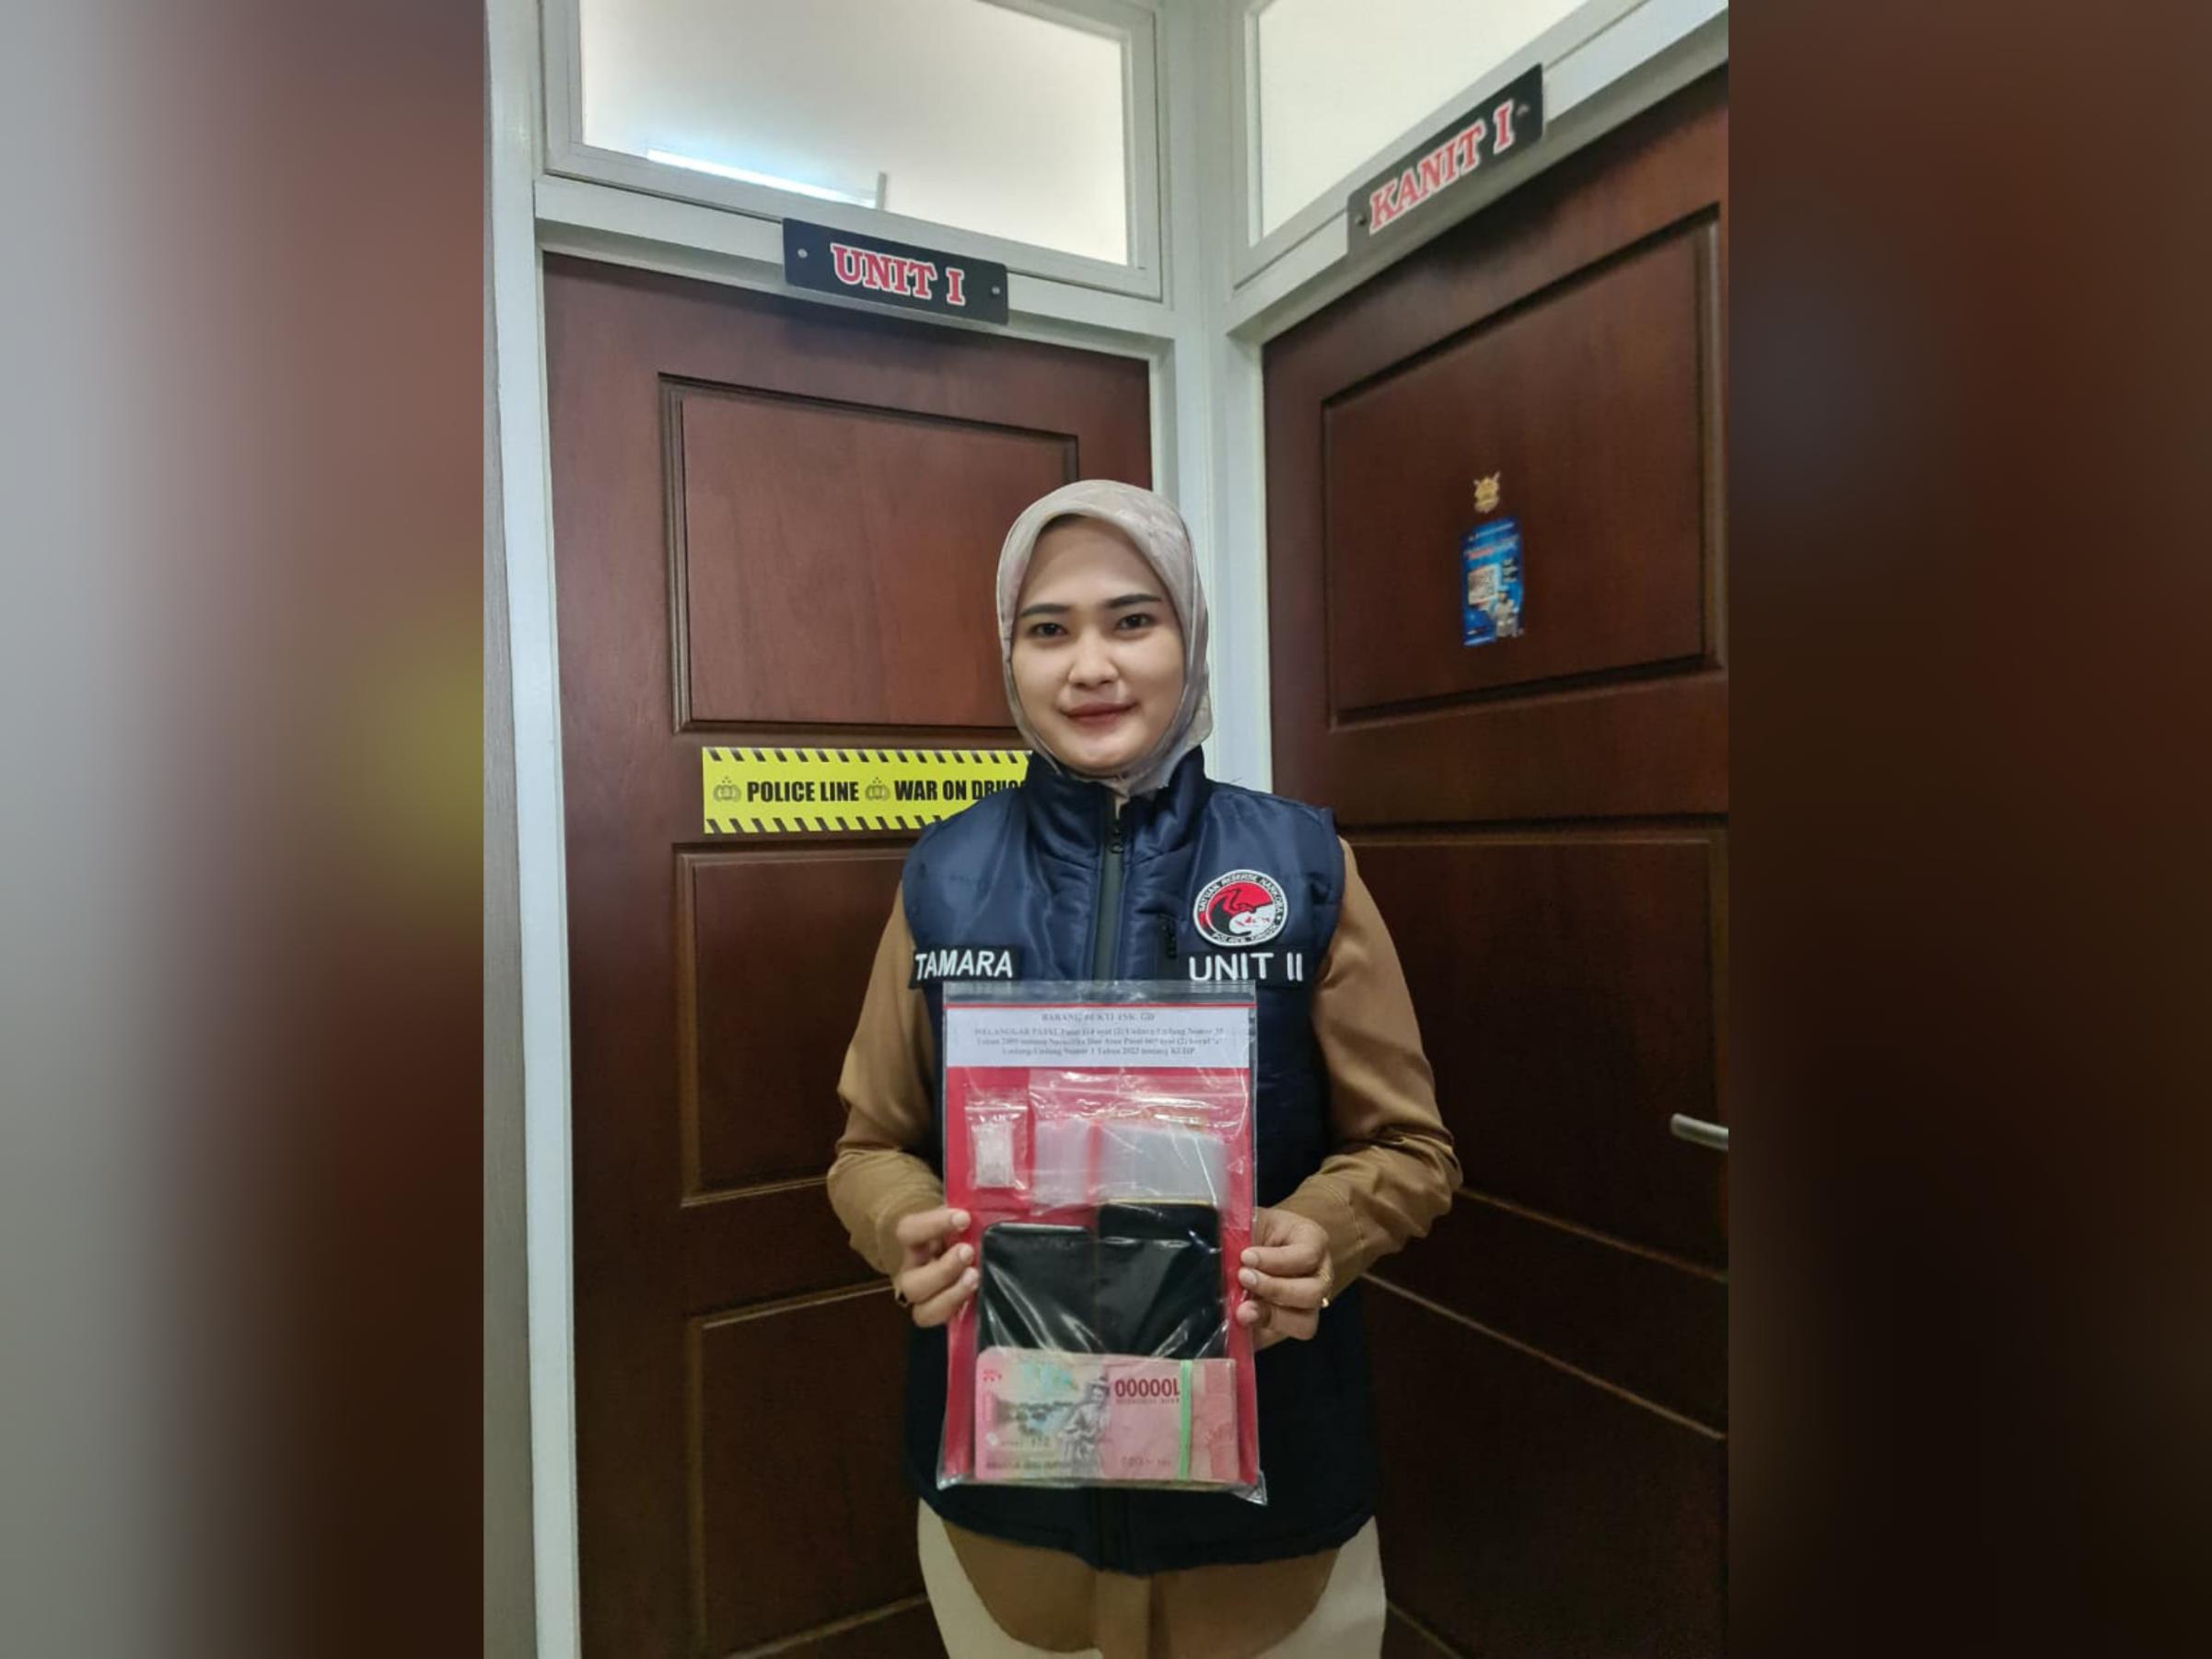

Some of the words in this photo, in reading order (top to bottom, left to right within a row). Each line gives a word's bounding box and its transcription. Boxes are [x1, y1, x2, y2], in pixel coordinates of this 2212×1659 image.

[1369, 118, 1486, 236] KANIT
[1493, 99, 1516, 155] I
[830, 242, 937, 299] UNIT
[945, 267, 965, 306] I
[747, 781, 814, 802] POLICE
[821, 783, 859, 802] LINE
[894, 780, 937, 801] WAR
[942, 780, 967, 801] ON
[914, 949, 1013, 981] TAMARA
[1189, 953, 1275, 981] UNIT
[1286, 952, 1303, 981] II
[1115, 1378, 1181, 1398] 100000
